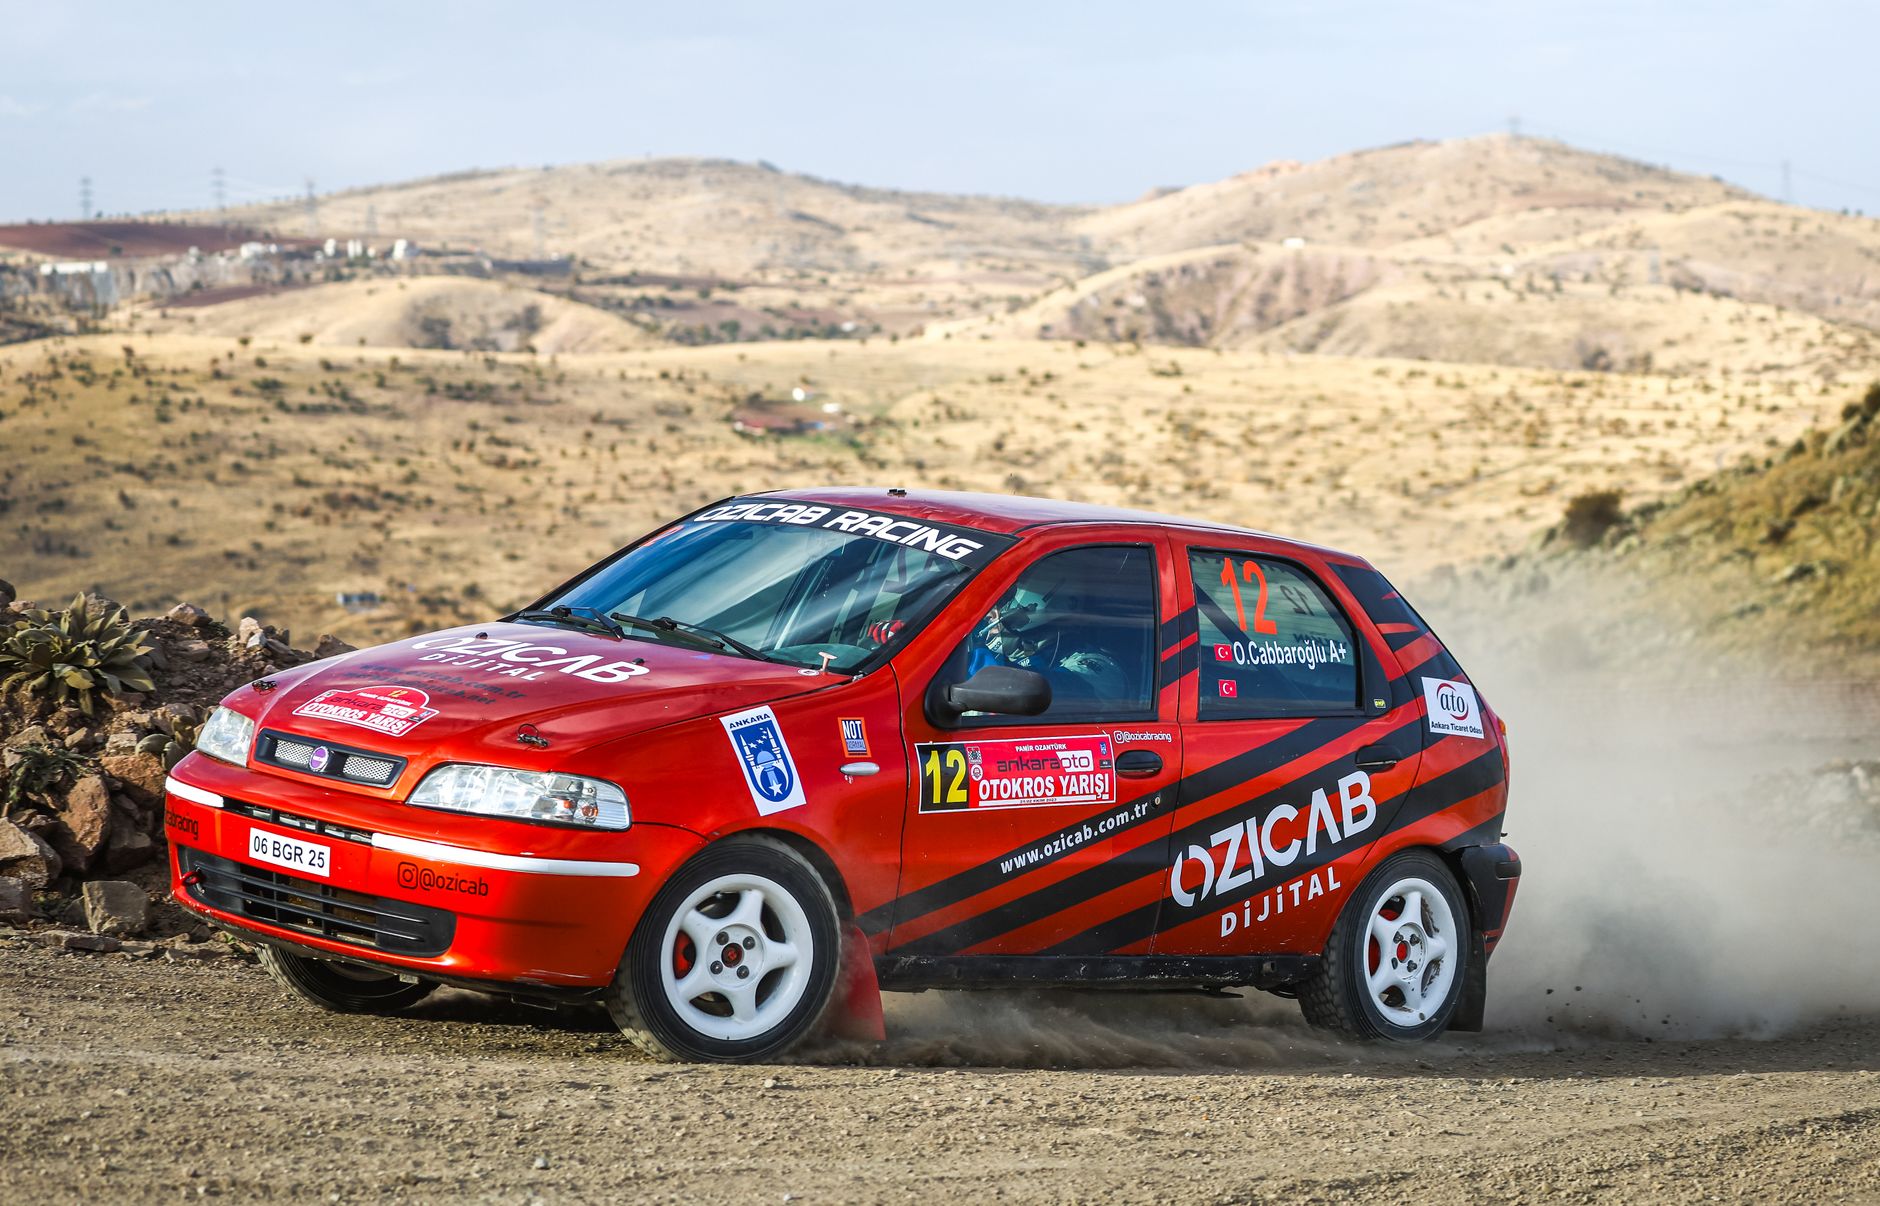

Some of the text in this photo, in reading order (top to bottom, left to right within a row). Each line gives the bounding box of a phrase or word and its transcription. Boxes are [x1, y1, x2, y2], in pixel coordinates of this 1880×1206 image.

[694, 504, 984, 561] OZICAB RACING
[1220, 557, 1277, 635] 12
[412, 636, 650, 683] OZICAB
[1233, 640, 1347, 670] O.Cabbaroğlu A+
[302, 702, 368, 720] OTOKROS
[1440, 690, 1465, 713] ato
[729, 713, 770, 729] ANKARA
[841, 720, 862, 739] NOT
[1431, 721, 1450, 730] Ankara
[1451, 723, 1468, 732] Ticaret
[925, 749, 967, 804] 12
[978, 773, 1109, 800] OTOKROS YARIŞI
[1000, 798, 1148, 874] www.ozicab.com.tr
[1170, 770, 1377, 907] OZICAB
[253, 835, 325, 869] 06 BGR 25
[419, 867, 489, 897] @ozicab
